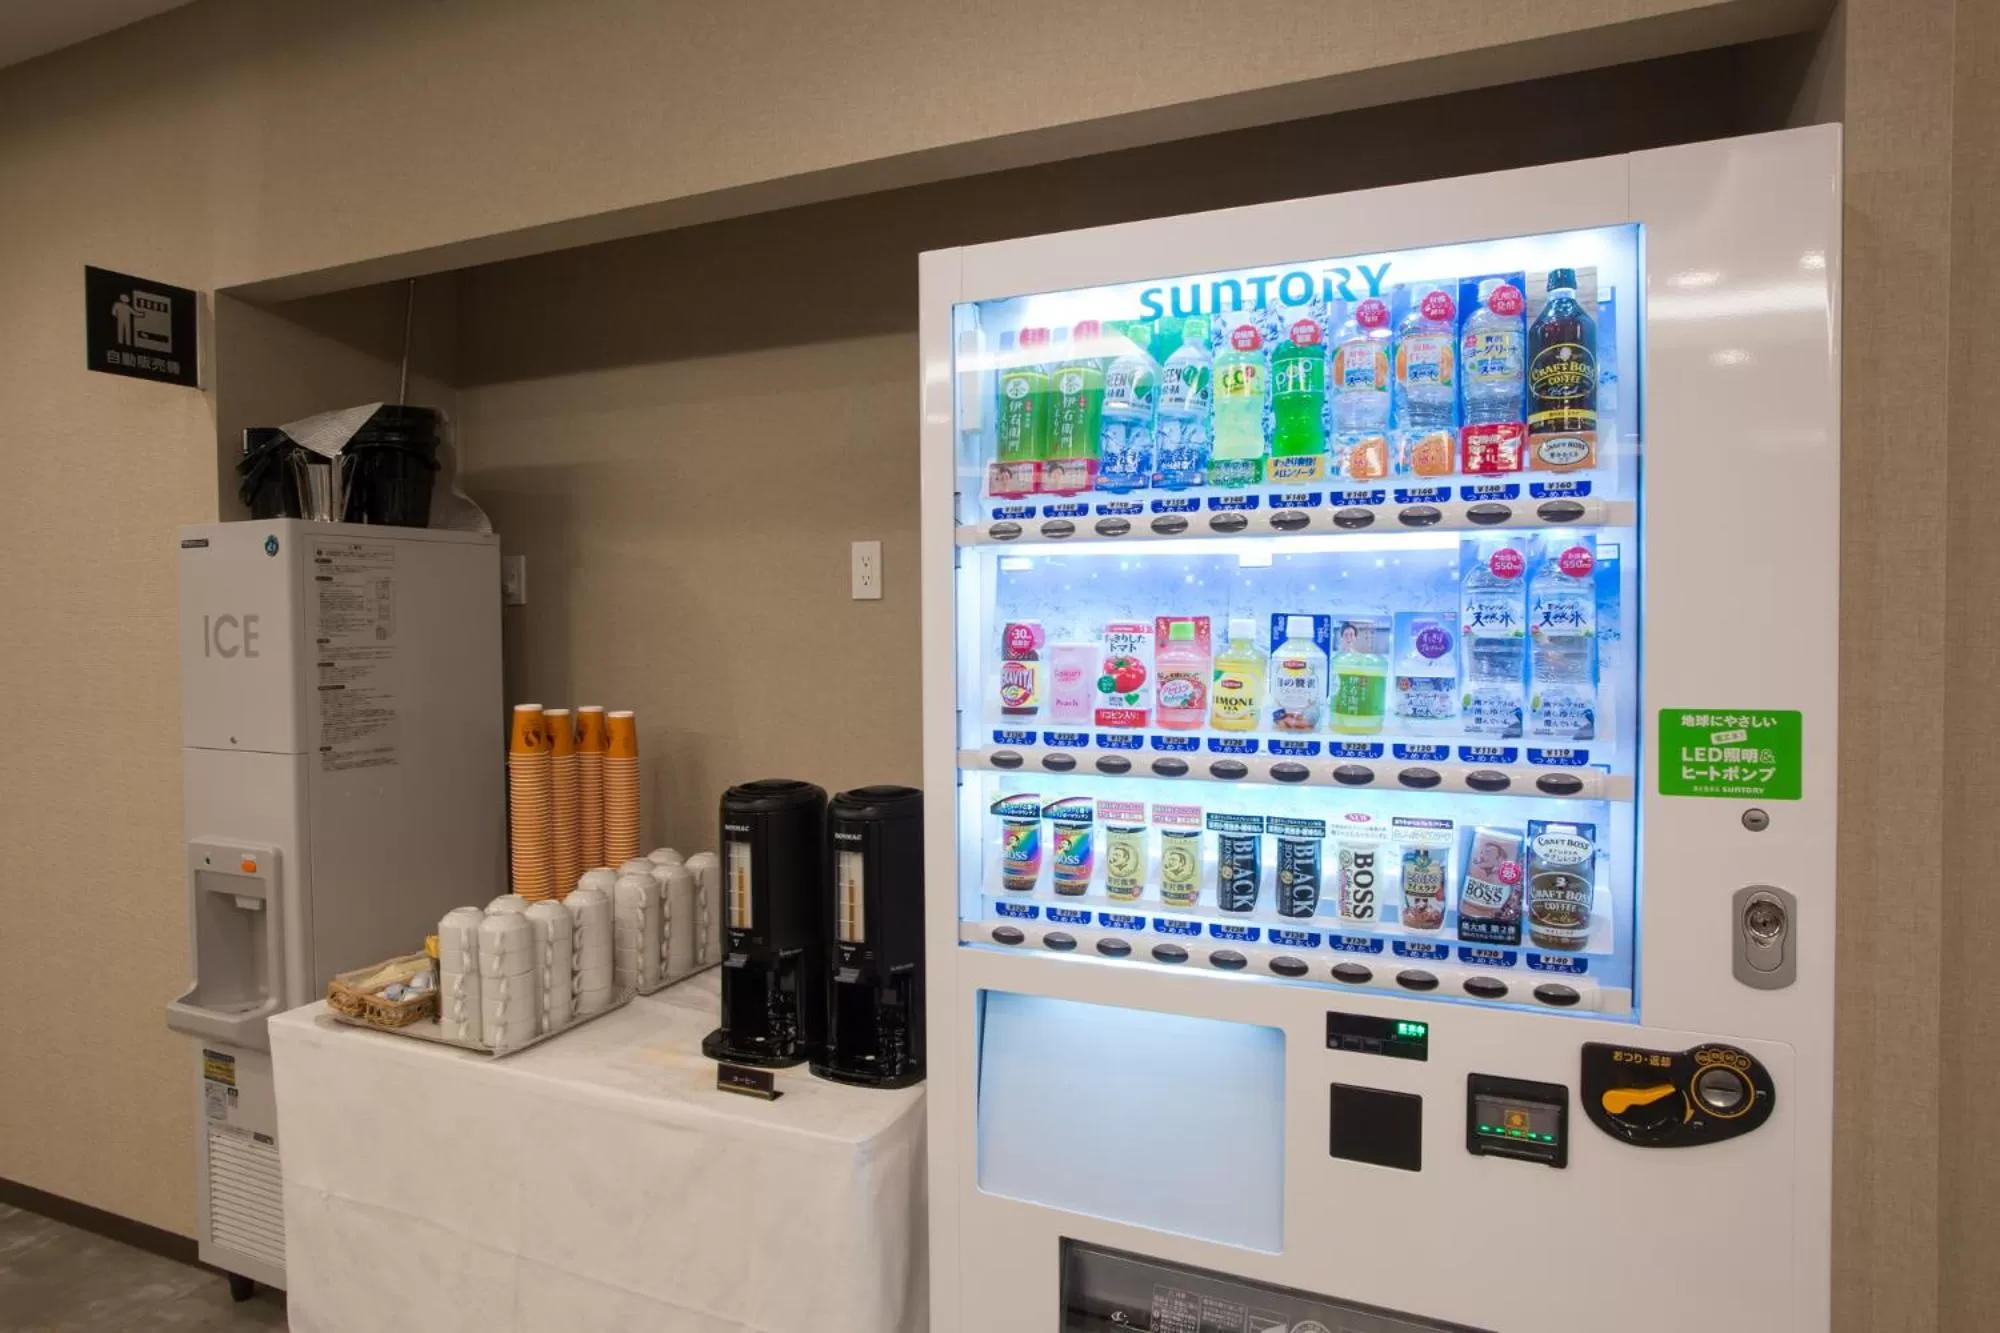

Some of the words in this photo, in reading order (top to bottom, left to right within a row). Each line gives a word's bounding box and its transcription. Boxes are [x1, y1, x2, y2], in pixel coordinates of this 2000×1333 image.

[1537, 490, 1584, 498] つめたい
[1472, 611, 1516, 628] 天然水
[1540, 611, 1586, 628] 天然水
[203, 614, 260, 658] ICE
[1110, 644, 1137, 652] トマト
[1681, 714, 1778, 729] 地球にやさしい
[1681, 766, 1777, 783] ヒートポンプ
[1538, 836, 1566, 846] CRAFT
[1567, 839, 1589, 850] BOSS
[1232, 839, 1255, 908] BLACK
[1292, 843, 1316, 914] BLACK
[1353, 851, 1374, 919] BOSS
[1466, 883, 1503, 902] BOSS
[1613, 1051, 1671, 1067] おつり・返却
